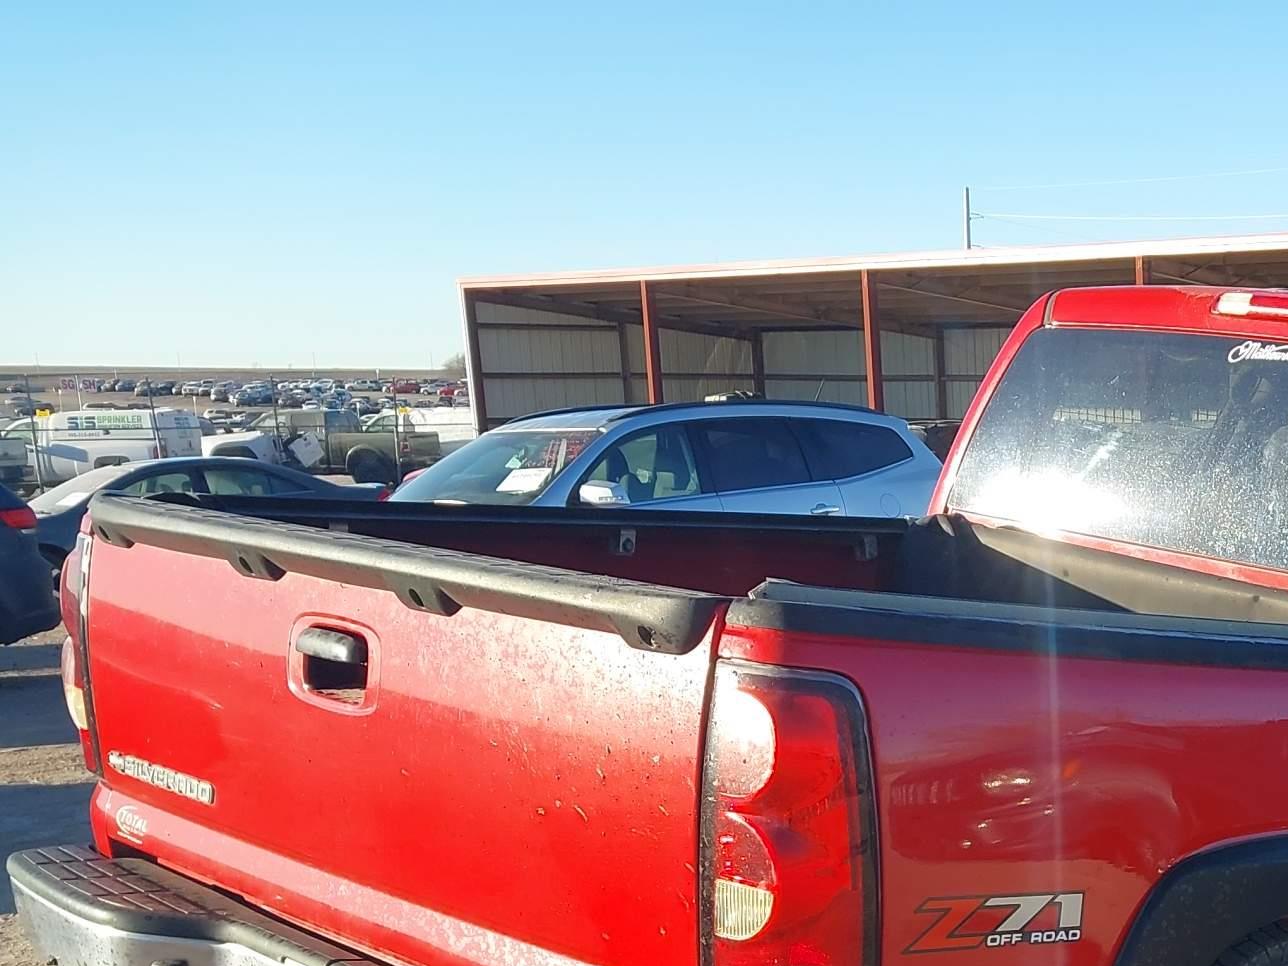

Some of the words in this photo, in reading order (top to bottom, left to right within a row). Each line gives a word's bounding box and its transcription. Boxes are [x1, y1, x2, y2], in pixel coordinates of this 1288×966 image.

[96, 415, 143, 424] SPRINKLER
[120, 809, 147, 833] TOTAL
[902, 890, 1085, 955] Z71
[986, 931, 1023, 947] OFF
[1031, 928, 1082, 944] ROAD
